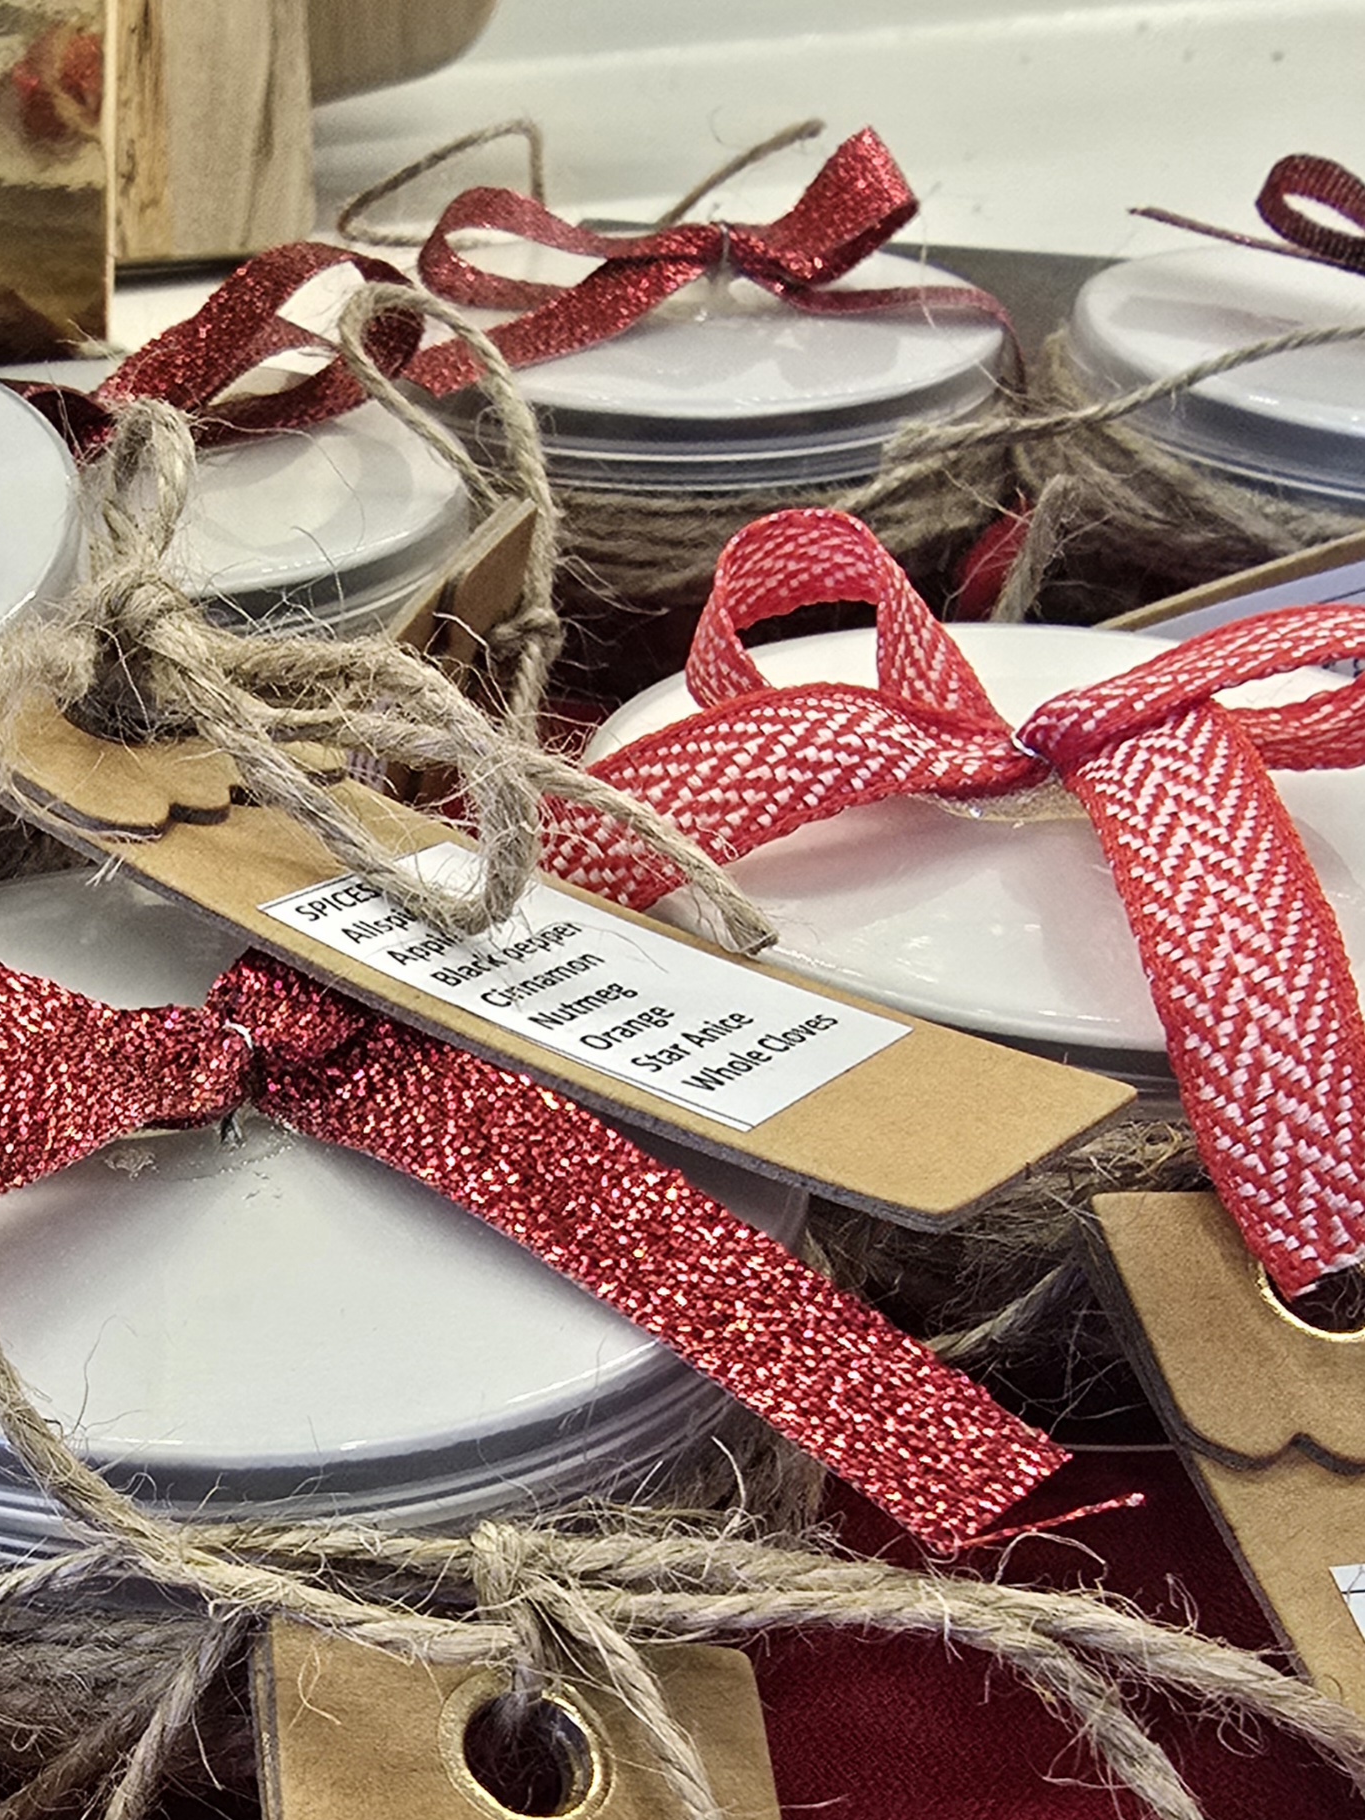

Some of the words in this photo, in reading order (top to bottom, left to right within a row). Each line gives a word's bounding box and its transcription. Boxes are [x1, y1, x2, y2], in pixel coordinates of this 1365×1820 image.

[295, 883, 383, 922] SPICES
[431, 951, 507, 987] Black
[502, 921, 583, 963] pepper
[480, 951, 605, 1008] Cinnamon
[528, 982, 638, 1030] Nutmeg
[580, 1005, 675, 1051] Orange
[631, 1042, 691, 1073] Star
[681, 1010, 754, 1049] Anice
[681, 1049, 773, 1092] Whole
[758, 1014, 839, 1053] Cloves
